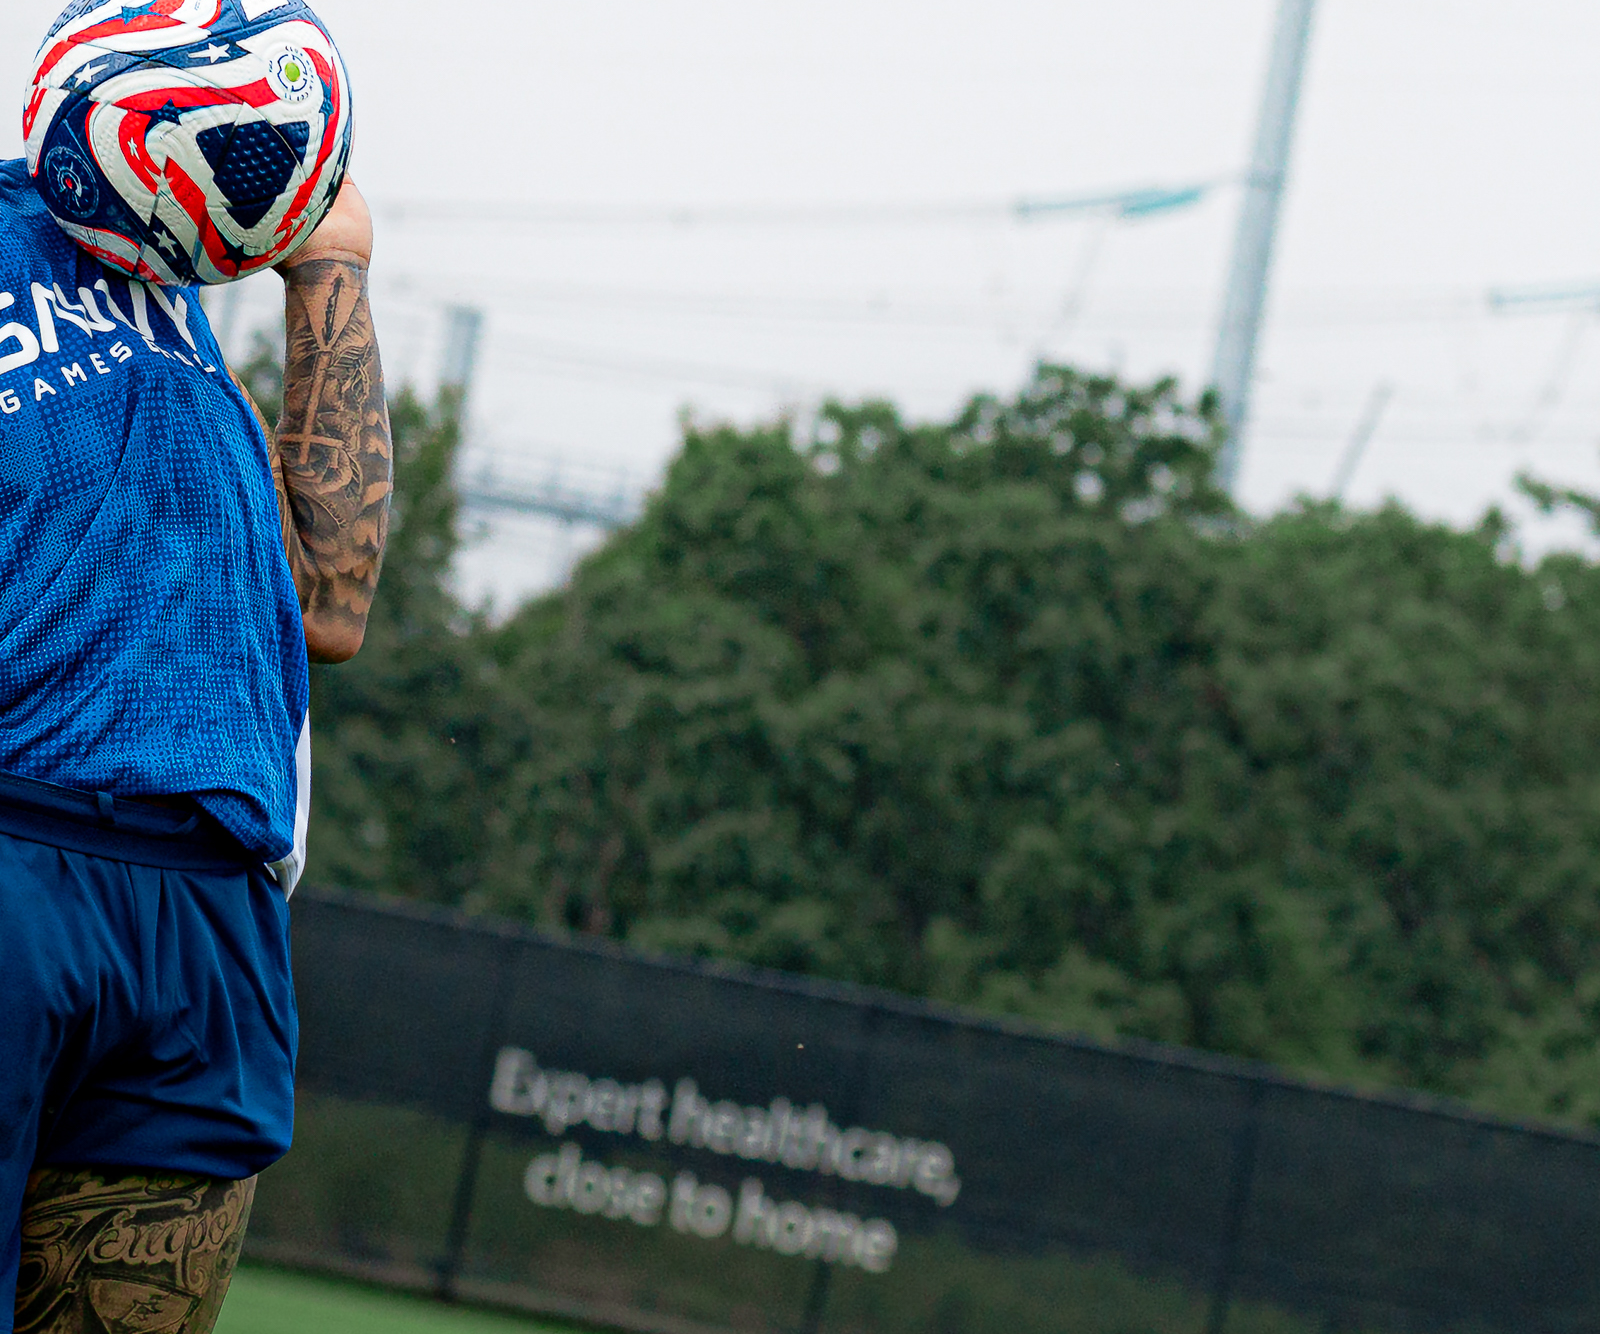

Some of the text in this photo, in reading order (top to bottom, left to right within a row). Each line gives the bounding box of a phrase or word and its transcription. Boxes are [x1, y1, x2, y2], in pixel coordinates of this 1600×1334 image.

[491, 1047, 962, 1206] Expert healthcare,
[524, 1142, 898, 1273] close to home
